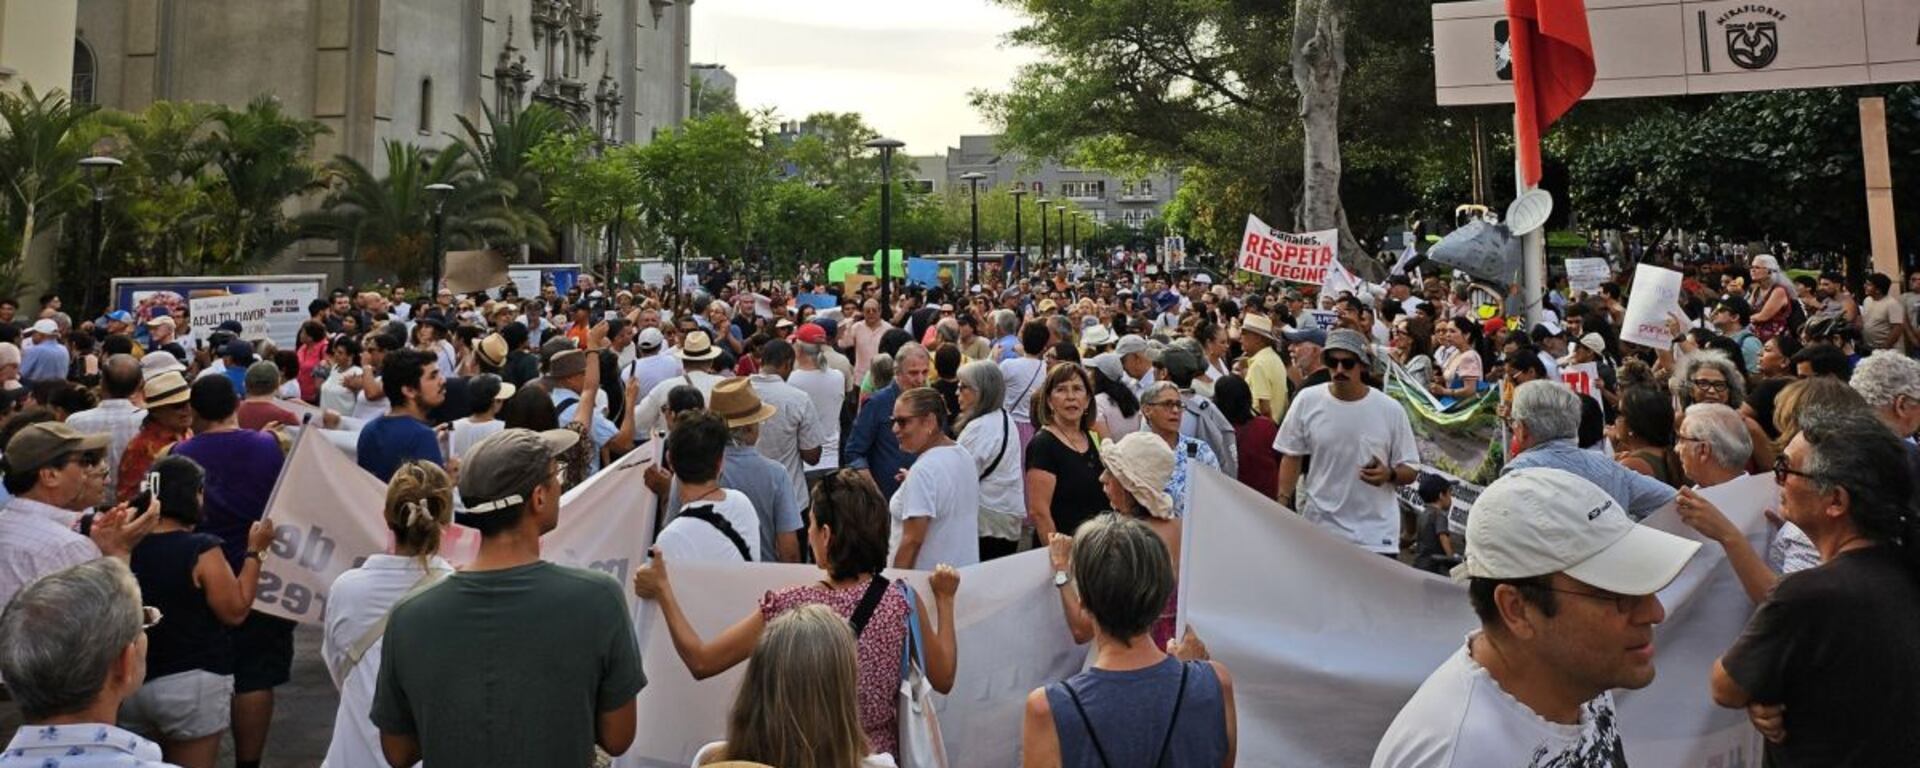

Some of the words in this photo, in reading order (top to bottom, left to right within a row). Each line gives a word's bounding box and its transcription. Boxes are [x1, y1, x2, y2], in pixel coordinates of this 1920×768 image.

[1717, 4, 1787, 25] MIRAFLORES
[1246, 232, 1332, 266] RESPETA
[1243, 255, 1263, 272] AL
